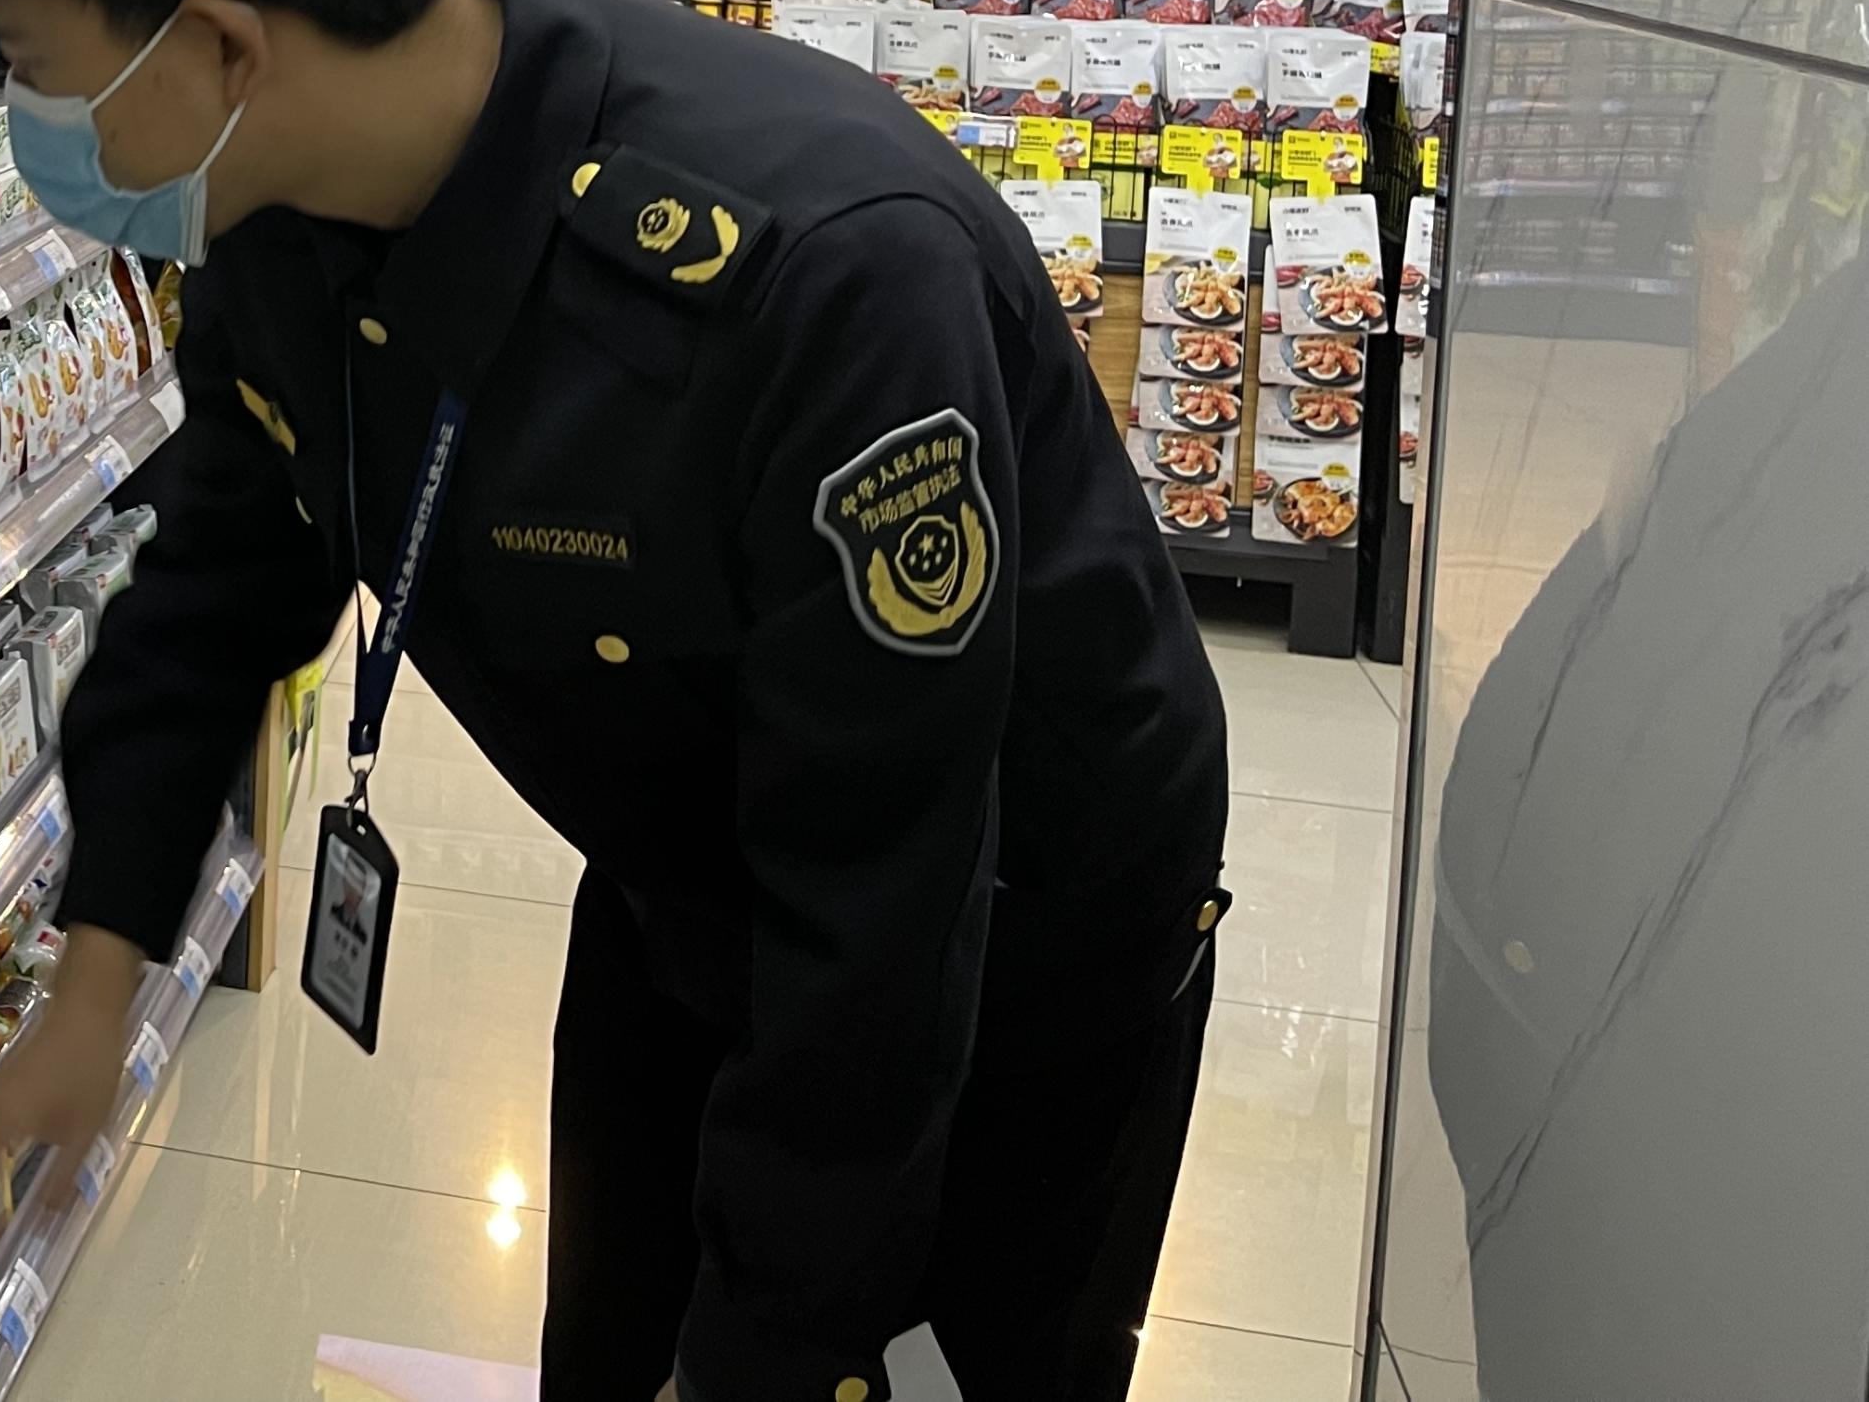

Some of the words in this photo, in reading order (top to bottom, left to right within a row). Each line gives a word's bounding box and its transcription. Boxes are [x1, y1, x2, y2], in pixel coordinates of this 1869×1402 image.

[839, 436, 964, 518] 中华人民共和国
[491, 526, 629, 562] 11040230024
